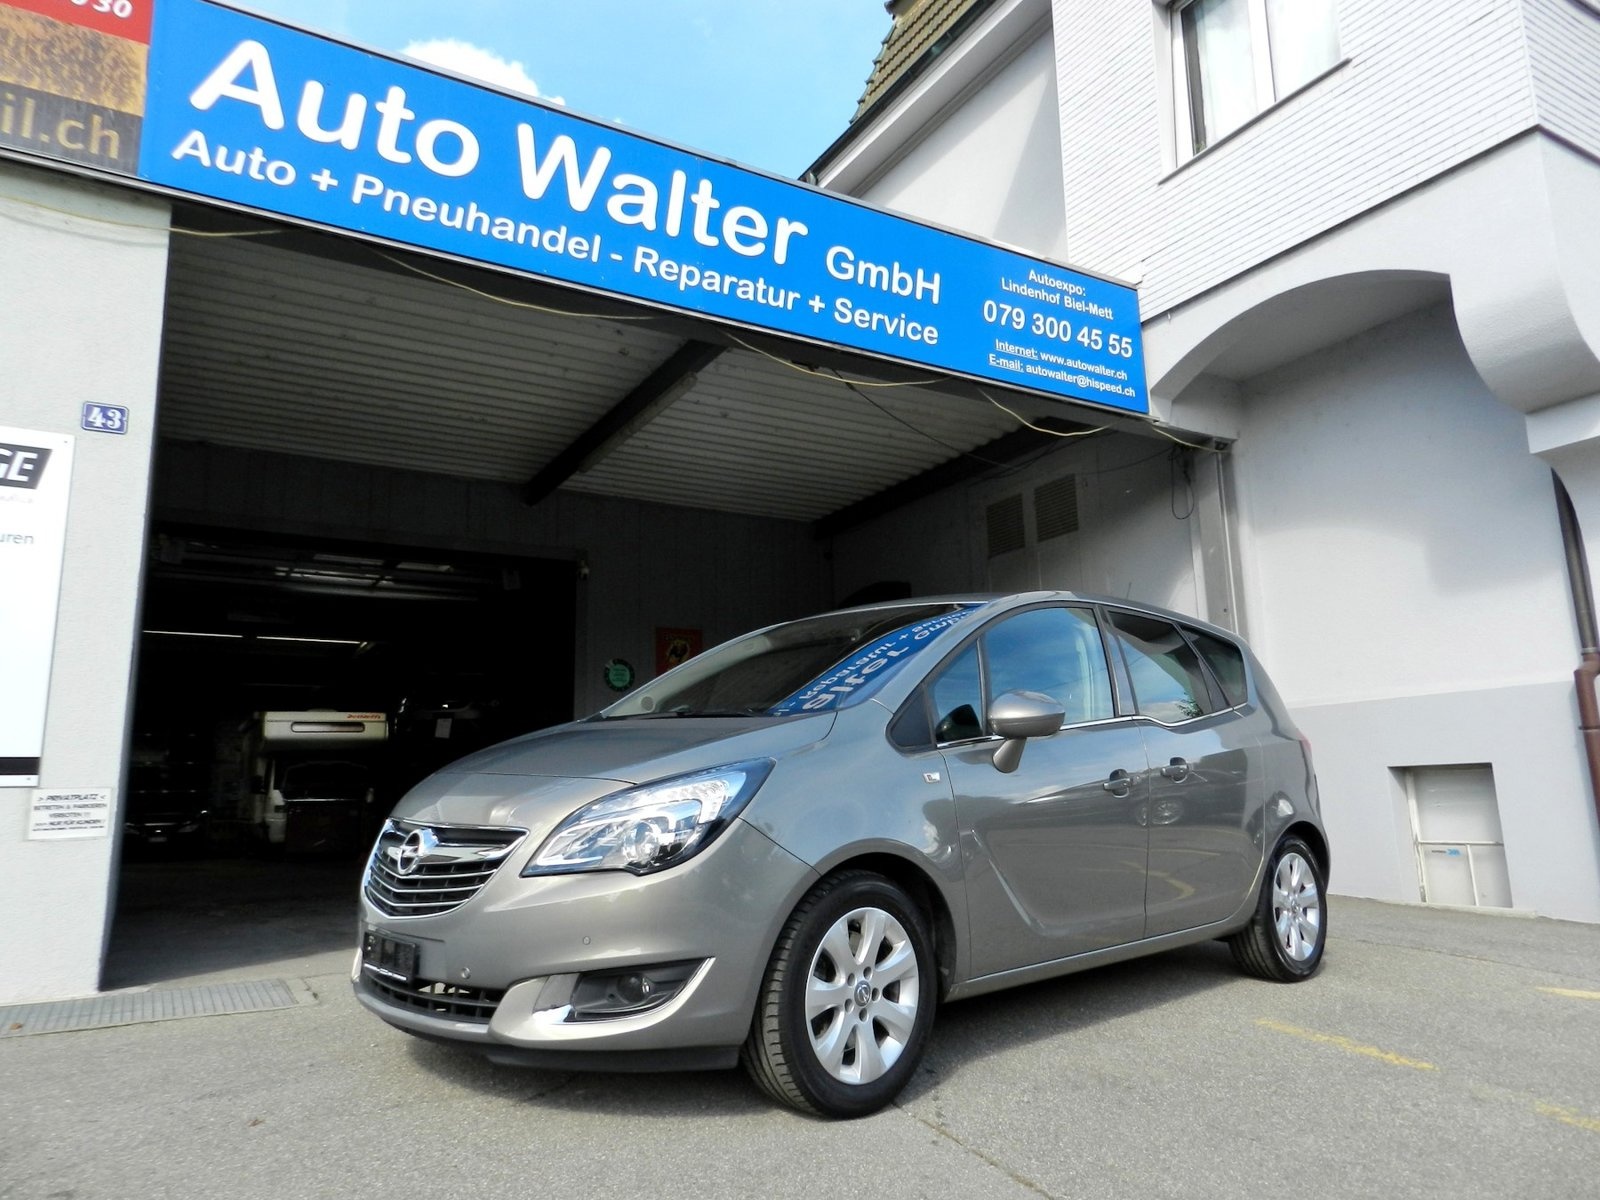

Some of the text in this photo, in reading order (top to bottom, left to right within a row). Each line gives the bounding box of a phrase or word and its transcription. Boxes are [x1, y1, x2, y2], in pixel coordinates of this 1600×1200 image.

[69, 0, 133, 19] 30
[189, 40, 941, 304] Auto Walter GmbH
[172, 130, 296, 186] Auto
[311, 168, 338, 191] +
[352, 173, 600, 263] Pneuhandel
[634, 246, 800, 310] Reparatur
[809, 295, 825, 313] +
[834, 298, 938, 345] Service
[1002, 277, 1114, 320] Lindenhof Biel-Mett
[1029, 269, 1086, 296] Autoexpo:
[983, 300, 1132, 358] 079 300 45 55
[989, 353, 1135, 397] E-mail: autowalter@hispeed.ch
[995, 339, 1127, 380] Internet: www.autowalter.ch
[88, 406, 122, 429] 43
